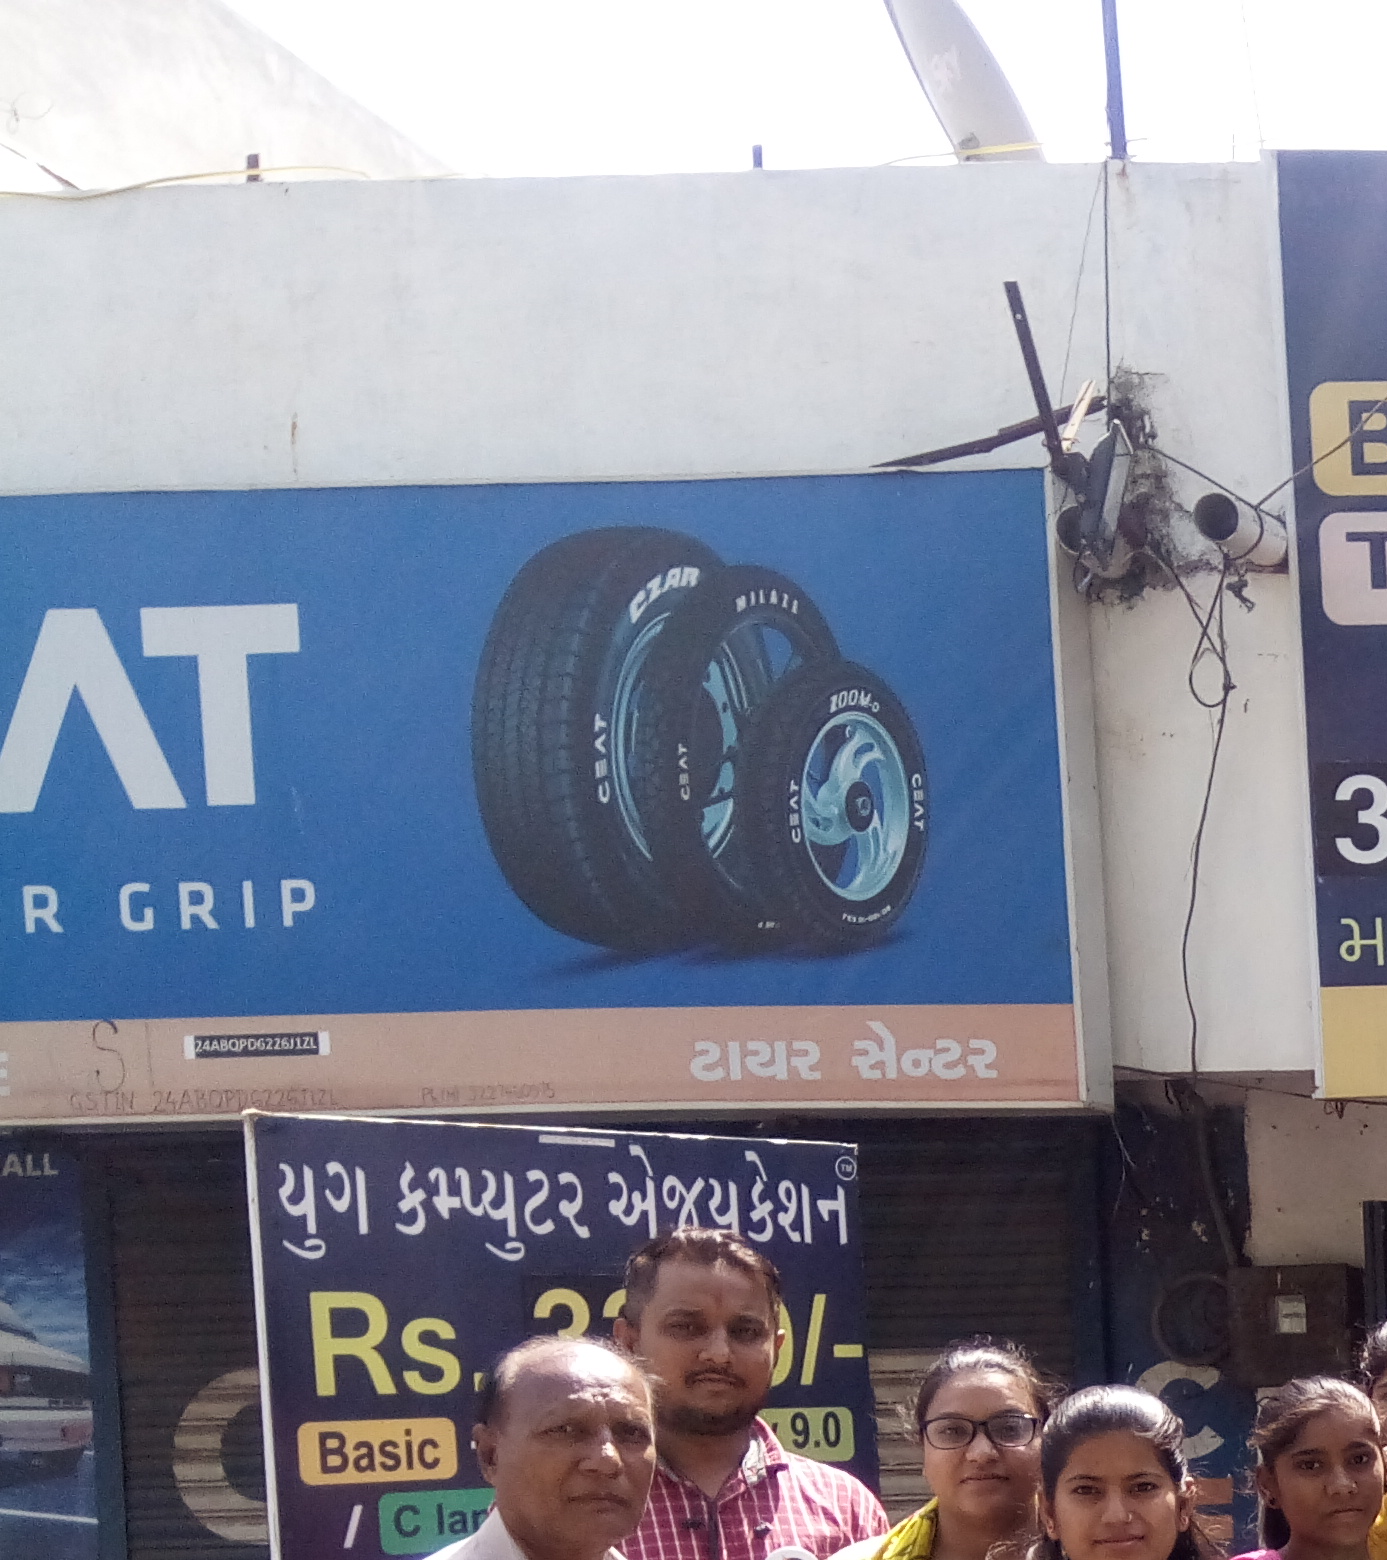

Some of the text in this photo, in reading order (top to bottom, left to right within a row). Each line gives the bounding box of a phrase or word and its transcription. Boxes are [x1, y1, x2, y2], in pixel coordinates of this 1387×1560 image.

[594, 714, 611, 804] CEAT
[679, 743, 691, 800] CEAT
[789, 780, 801, 843] CEAT
[911, 773, 925, 831] CEAT
[118, 879, 317, 932] GRIP
[690, 1021, 999, 1082] ટાયર સેન્ટર
[278, 1161, 369, 1260] યુગ
[319, 1429, 441, 1475] Basic
[790, 1409, 842, 1449] 9.0
[393, 1508, 421, 1539] C
